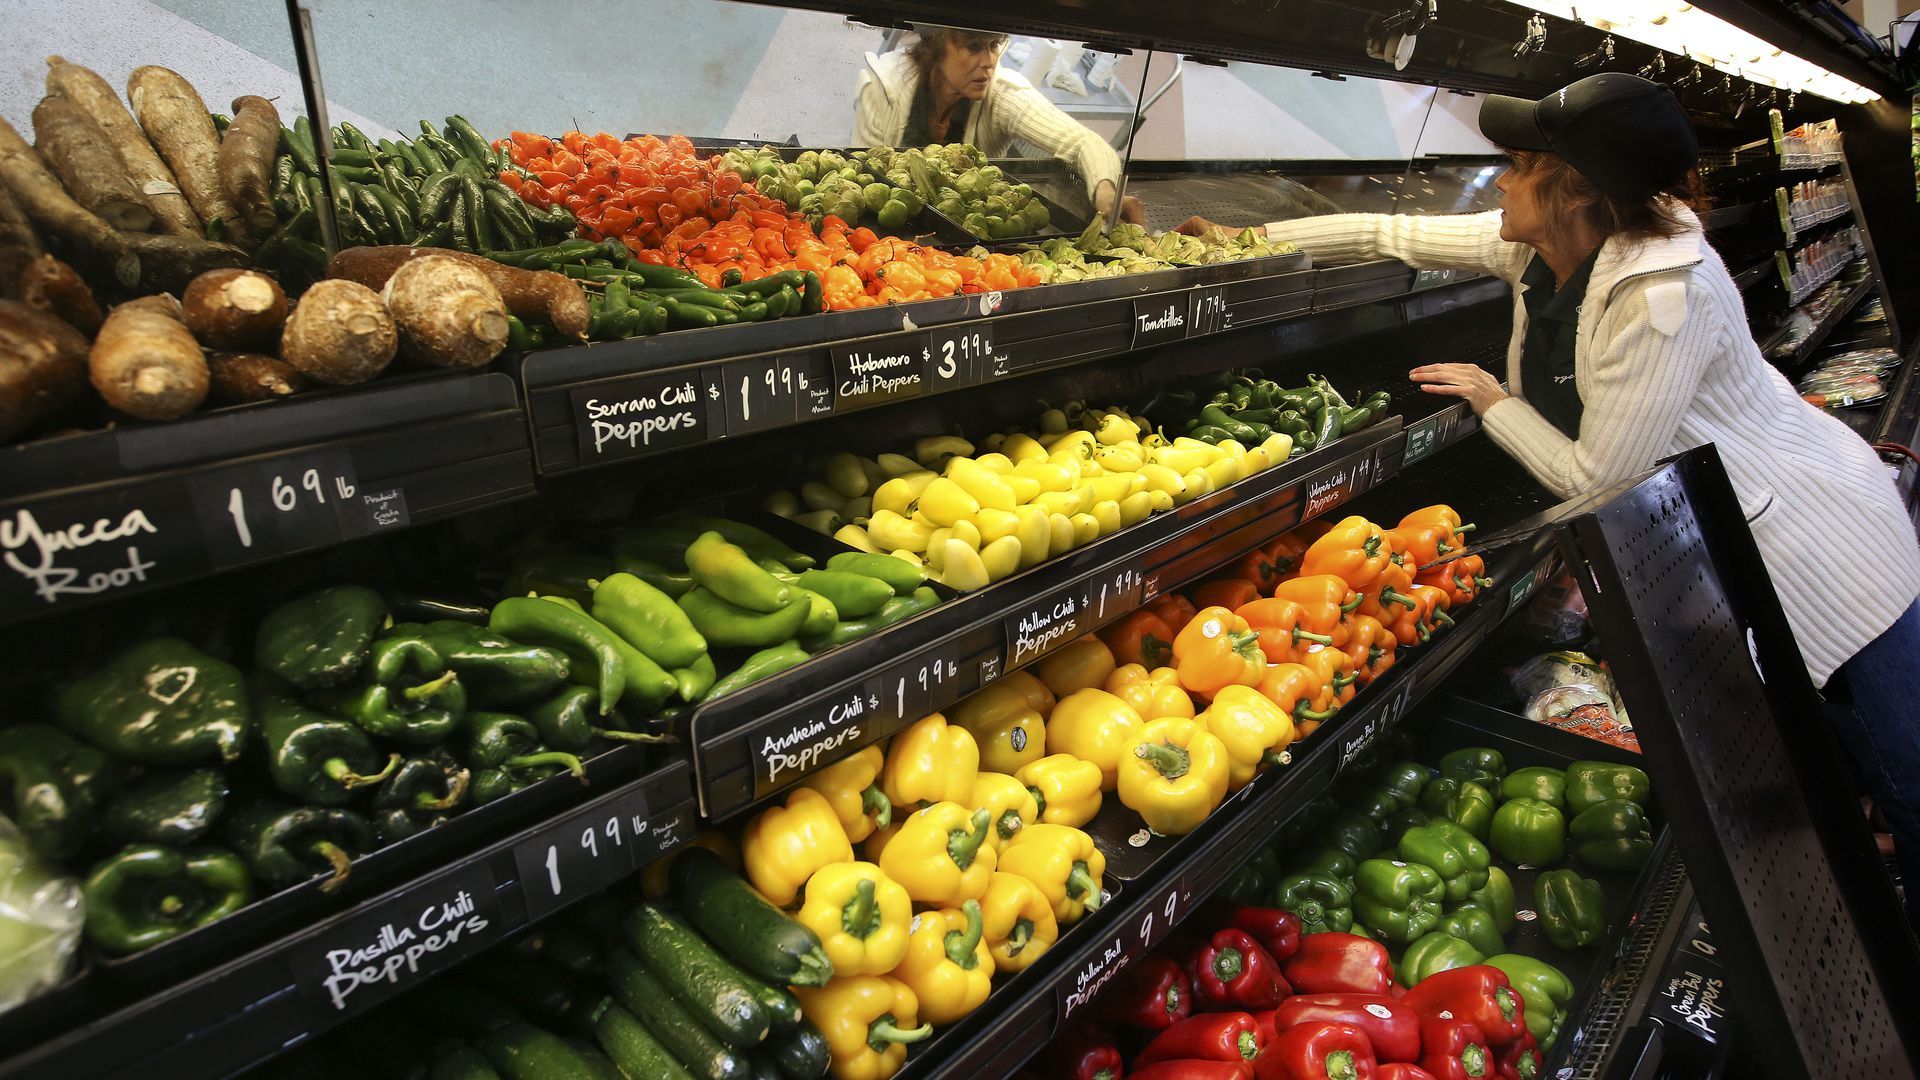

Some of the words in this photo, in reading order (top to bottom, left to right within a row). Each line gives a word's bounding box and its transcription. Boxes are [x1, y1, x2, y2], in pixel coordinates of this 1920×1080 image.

[1138, 305, 1184, 333] Tomatillos
[839, 374, 869, 398] Chili
[871, 370, 922, 397] Peppers
[848, 352, 911, 376] Habanero
[922, 345, 931, 363] $
[937, 340, 957, 379] 3
[586, 395, 657, 420] Serrano
[660, 382, 697, 407] Chili
[709, 381, 720, 401] $
[740, 375, 750, 421] 1
[798, 372, 809, 390] lb
[591, 411, 697, 454] Peppers
[228, 487, 253, 547] 1
[336, 476, 355, 499] lb
[1, 508, 157, 574] Yucca
[33, 546, 156, 602] Root
[1015, 618, 1077, 663] Peppers
[1018, 611, 1051, 641] Yellow
[1053, 597, 1075, 620] Chili
[896, 677, 905, 719] 1
[948, 662, 957, 678] lb
[761, 719, 826, 757] Anaheim
[828, 695, 863, 725] Chili
[766, 724, 861, 783] Peppers
[545, 845, 561, 896] 1
[632, 815, 647, 836] lb
[326, 923, 416, 976] Pasilla
[419, 890, 475, 932] Chili
[323, 914, 489, 1010] Peppers
[1065, 954, 1129, 1019] Peppers
[1077, 960, 1104, 993] Yellow
[1104, 938, 1121, 965] Bell
[1684, 970, 1703, 992] Bell
[1671, 989, 1698, 1016] Green
[1685, 978, 1726, 1034] Peppers
